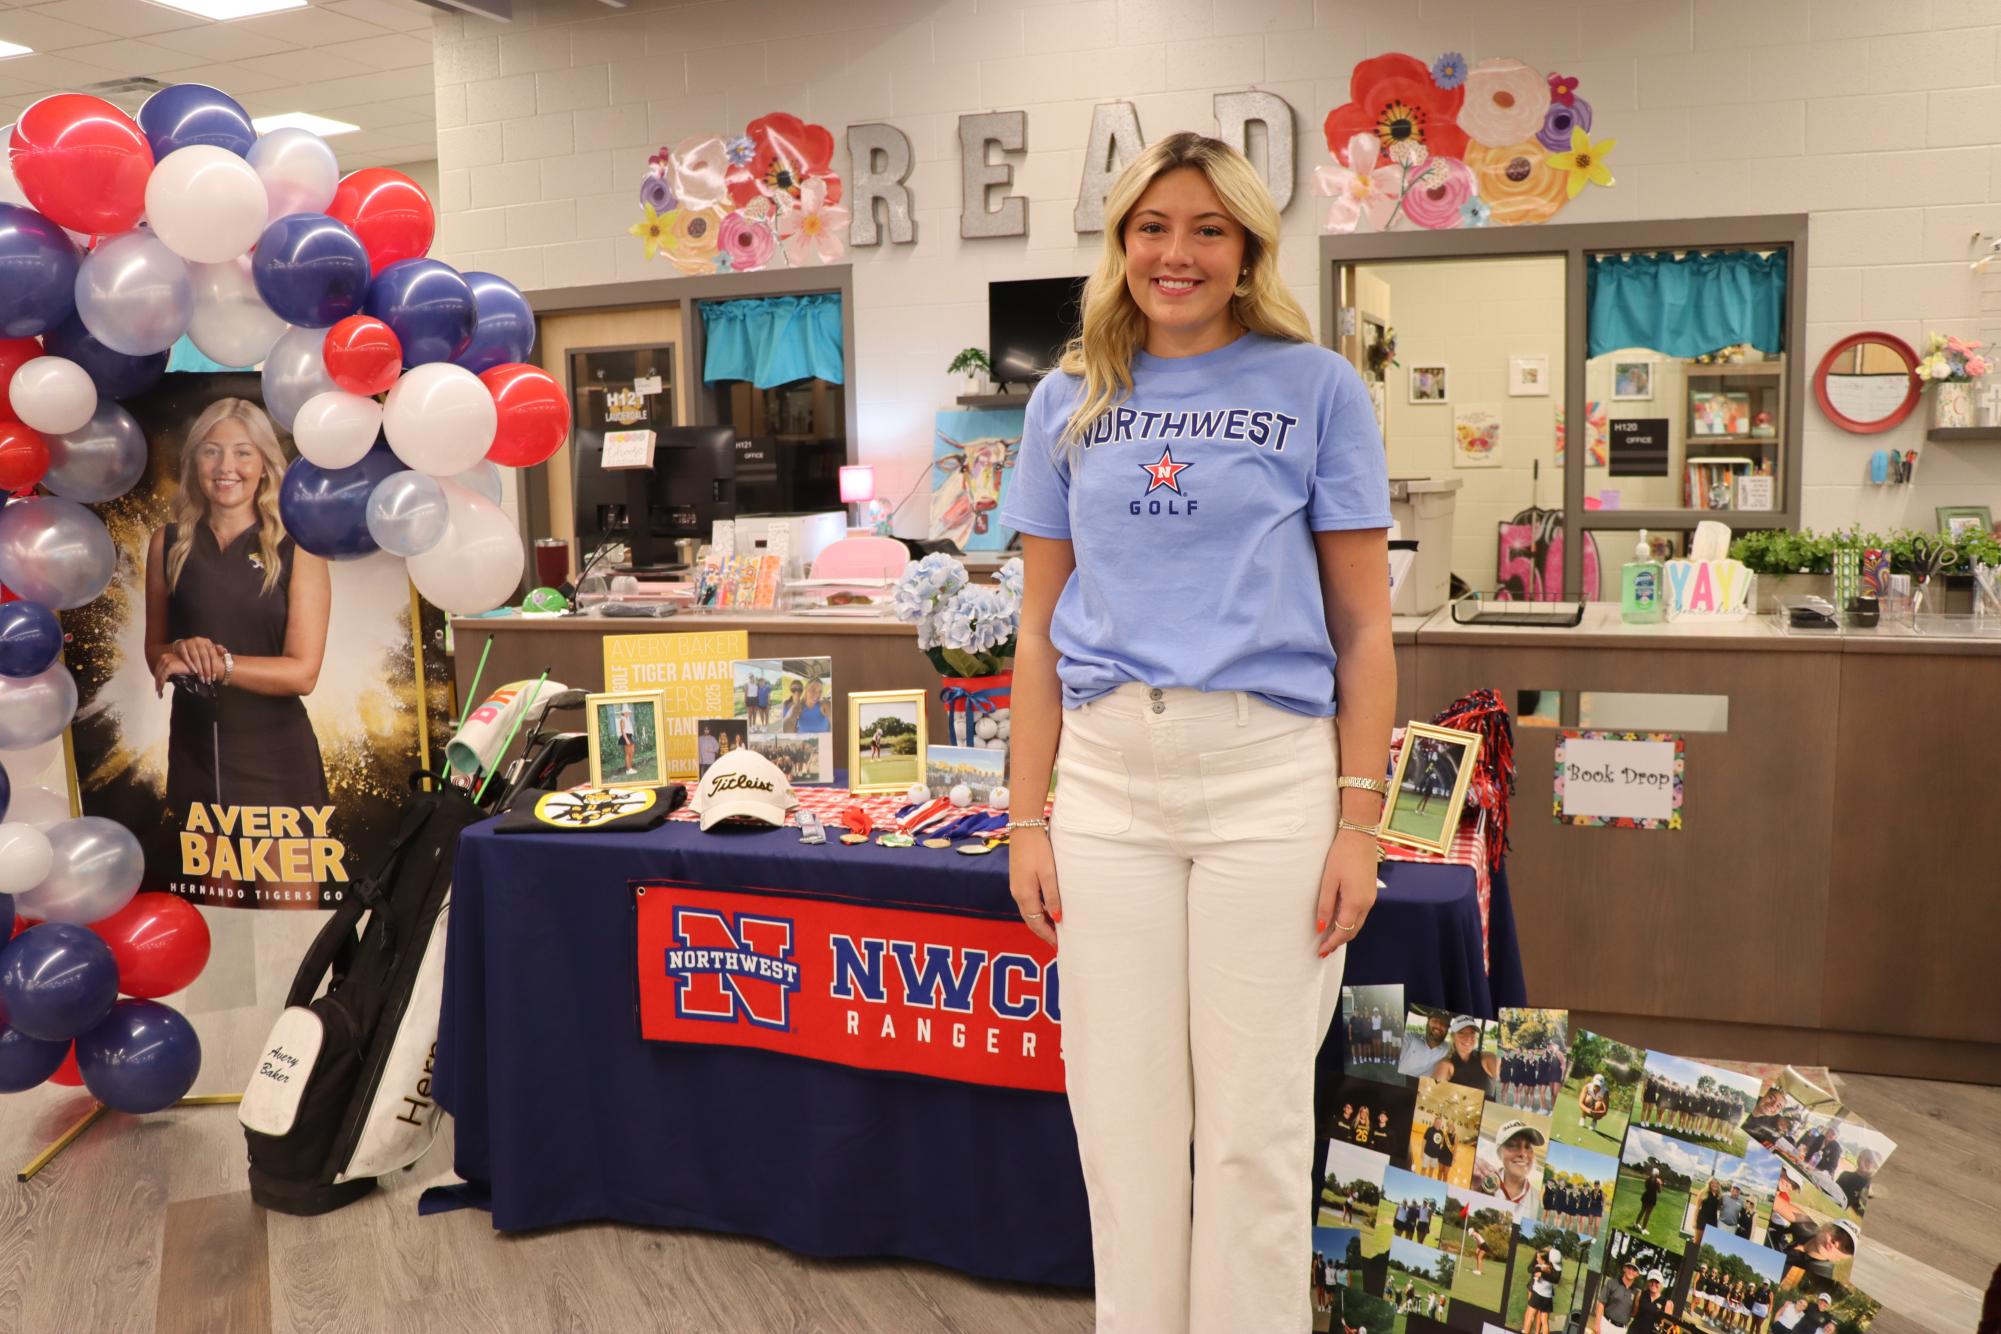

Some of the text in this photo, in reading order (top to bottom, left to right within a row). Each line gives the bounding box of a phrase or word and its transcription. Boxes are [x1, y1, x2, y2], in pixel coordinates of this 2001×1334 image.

[605, 410, 648, 422] LAUDERDALE
[1614, 423, 1638, 432] H120
[1157, 466, 1171, 478] N
[1129, 500, 1198, 516] GOLF
[1669, 562, 1737, 612] YAY
[611, 635, 739, 659] AVERY BAKER
[631, 662, 677, 683] TIGER
[705, 683, 721, 712] 2025
[708, 772, 775, 797] Titleist
[1567, 763, 1670, 790] Book Drop
[185, 802, 336, 837] AVERY
[179, 831, 350, 883] BAKER
[170, 883, 343, 901] HERNANDO TIGERS GO
[669, 951, 798, 983] NORTHWEST
[847, 1010, 1065, 1061] RANGER
[267, 1046, 300, 1068] Avery
[259, 1062, 290, 1084] Baker
